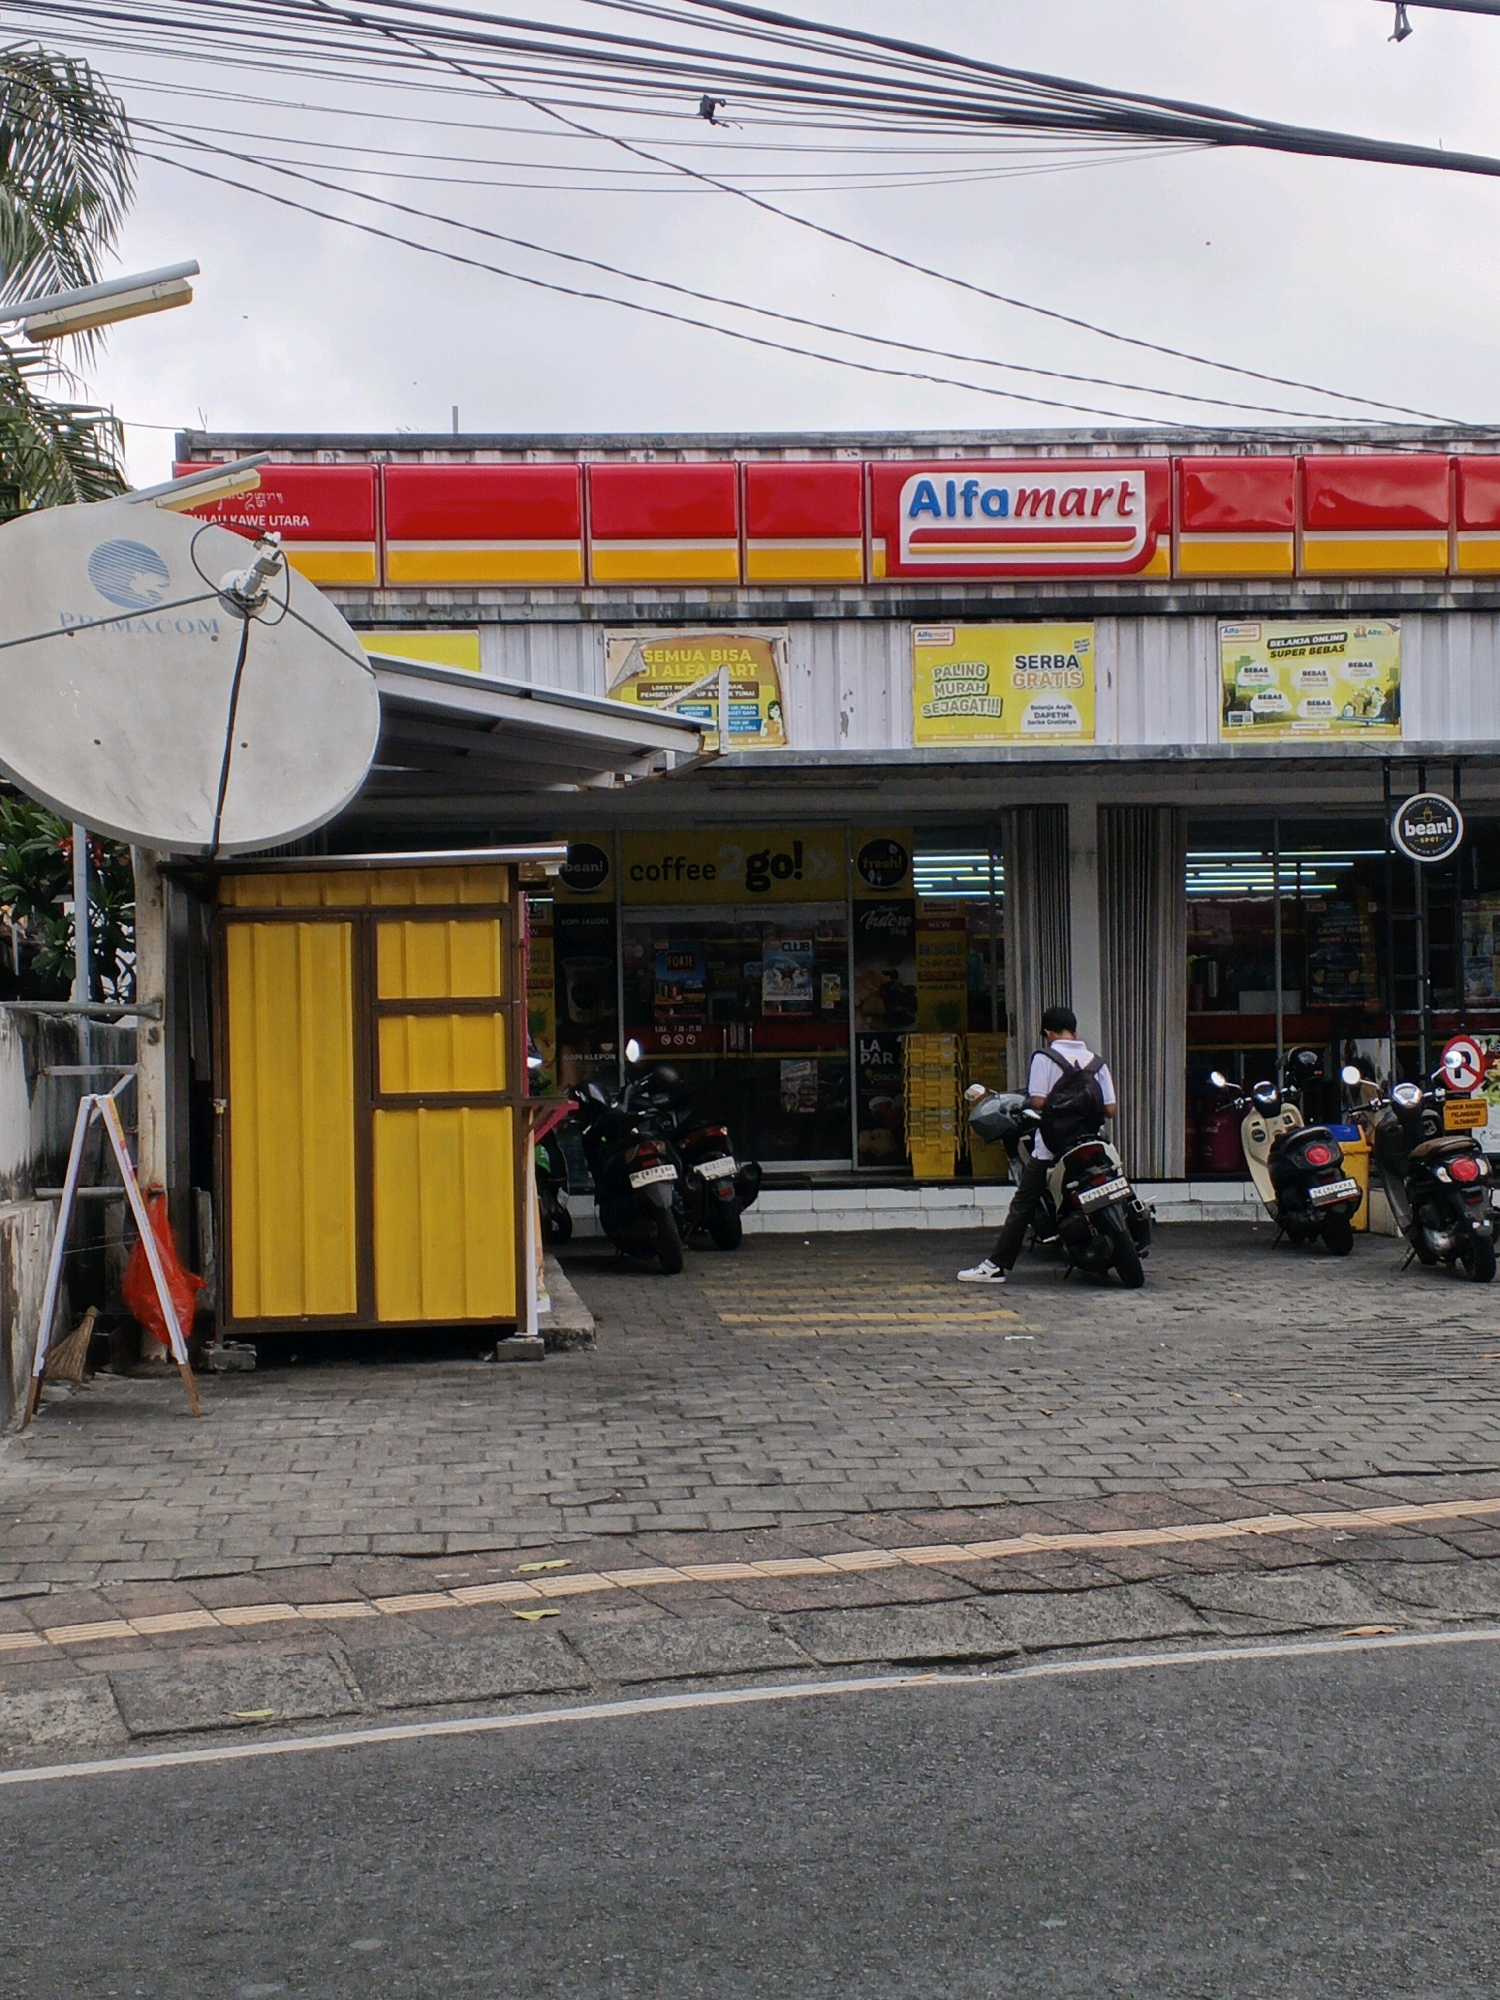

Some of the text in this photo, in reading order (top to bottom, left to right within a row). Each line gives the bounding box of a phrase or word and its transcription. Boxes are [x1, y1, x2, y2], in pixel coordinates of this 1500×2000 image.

[908, 479, 1137, 518] Alfamart
[230, 514, 266, 526] KAWE
[269, 515, 310, 526] UTARA
[58, 612, 221, 634] PRIMACOM
[1269, 633, 1345, 648] BELANJA ONLINE
[643, 649, 752, 663] SEMUA BISA
[1270, 644, 1345, 658] SUPER BEBAS
[661, 663, 758, 677] ALFAART
[1015, 655, 1079, 670] SERBA
[933, 663, 986, 679] PALING
[1012, 671, 1083, 688] GRATIS
[934, 683, 986, 696] MURAH
[922, 699, 999, 715] SEJAGAT!!!
[1404, 816, 1453, 836] bean!
[629, 856, 717, 881] coffee
[746, 841, 803, 891] go!
[860, 1039, 881, 1052] LA
[860, 1052, 894, 1065] PAR
